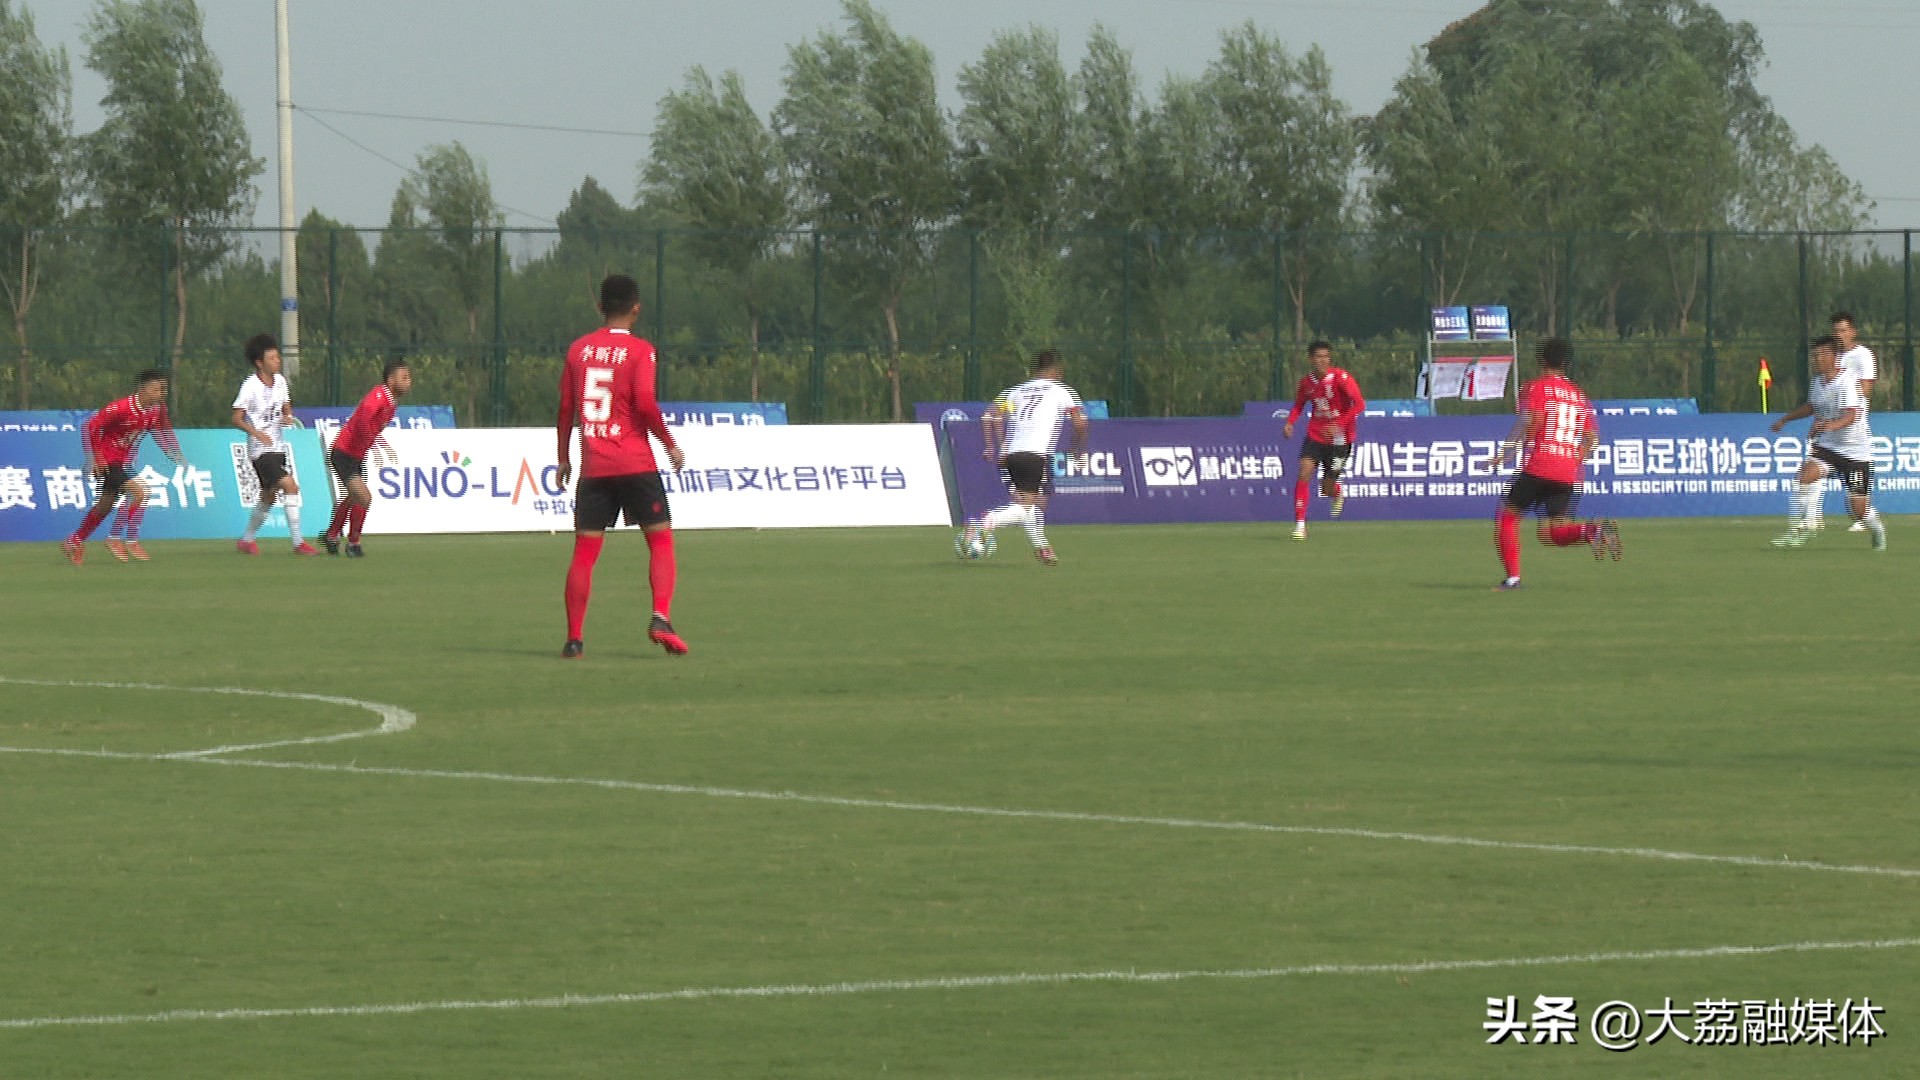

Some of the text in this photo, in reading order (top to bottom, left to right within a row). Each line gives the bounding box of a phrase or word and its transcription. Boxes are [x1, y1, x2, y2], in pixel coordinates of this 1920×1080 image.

[582, 367, 614, 421] 5
[1053, 452, 1122, 476] CMCL
[1391, 481, 1425, 497] LIFE
[1428, 481, 1465, 497] 2022
[1613, 479, 1707, 494] ASSOCIATION
[1711, 478, 1778, 493] MEMBER
